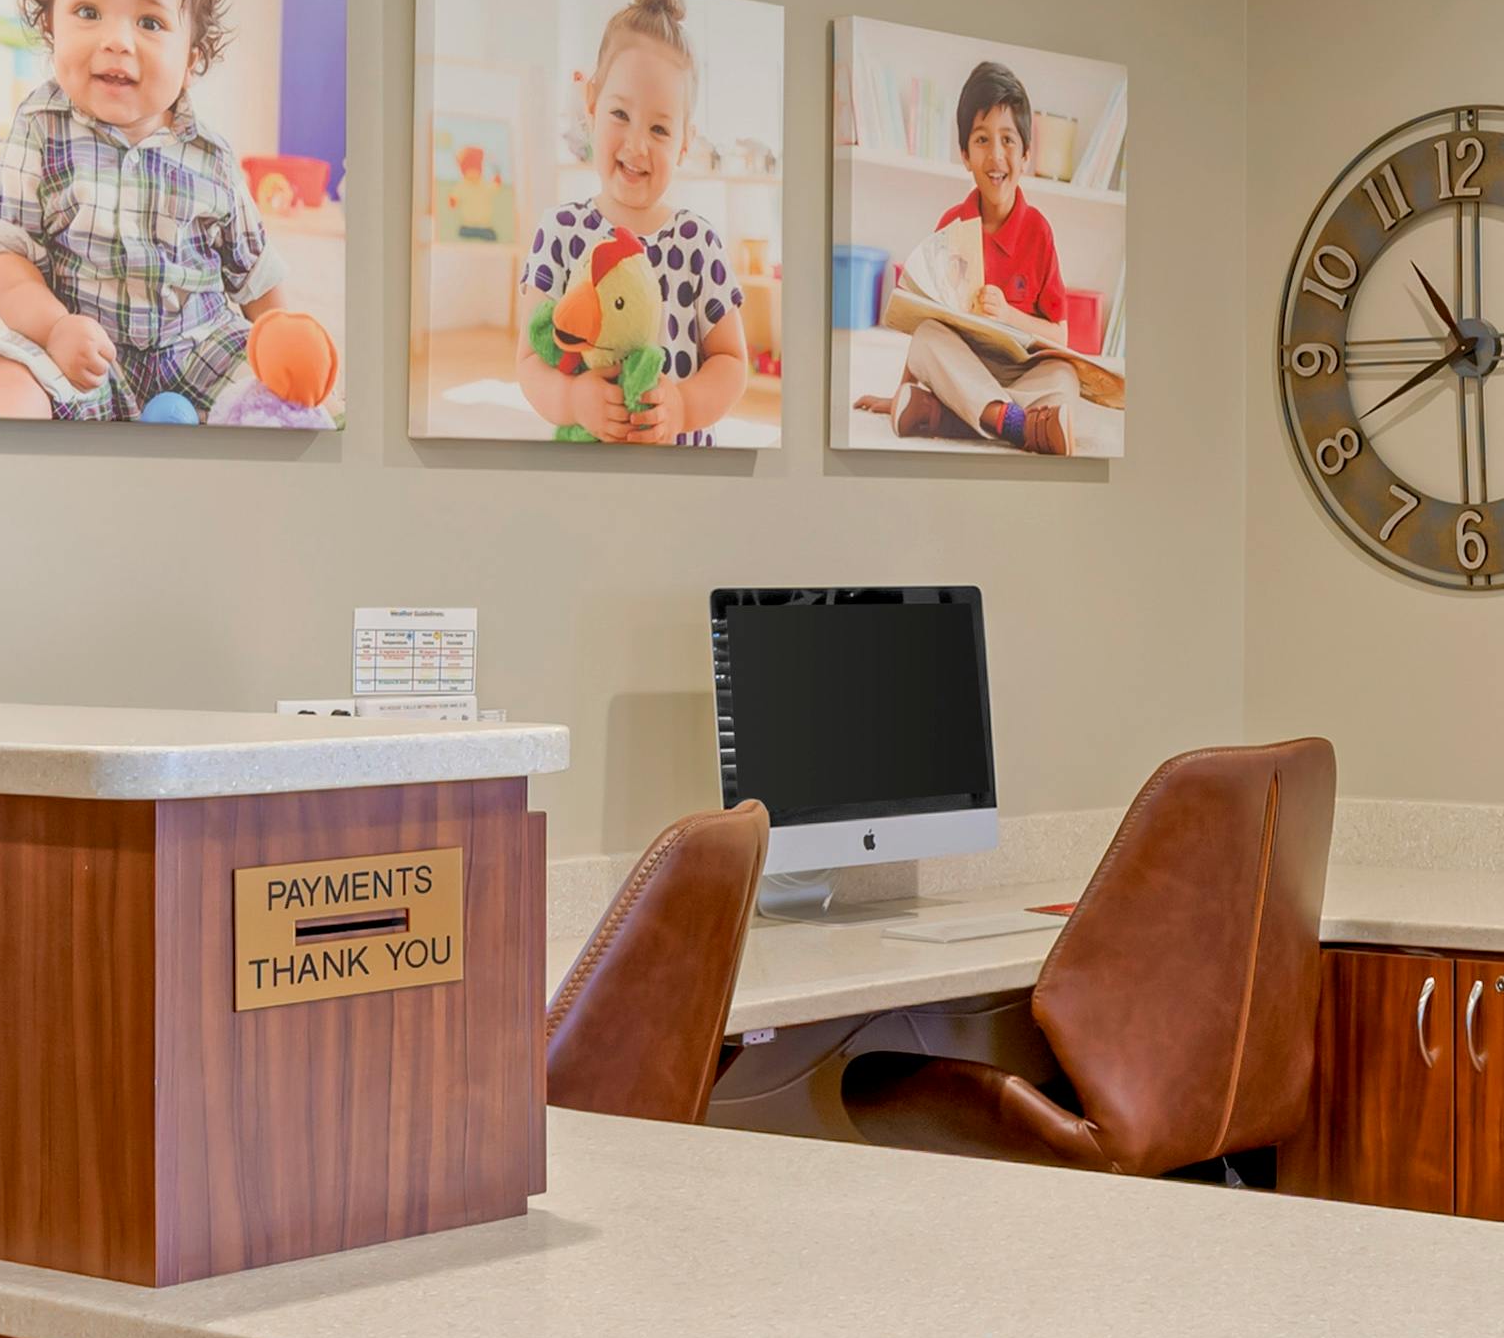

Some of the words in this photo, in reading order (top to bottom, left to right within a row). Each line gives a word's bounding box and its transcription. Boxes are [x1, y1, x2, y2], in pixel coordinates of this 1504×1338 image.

[1433, 136, 1485, 200] 12
[1362, 163, 1412, 233] 11
[1302, 245, 1359, 311] 10
[1290, 342, 1339, 378] 9
[1316, 427, 1361, 477] 8
[1379, 483, 1421, 542] 7
[1455, 510, 1488, 571] 6
[267, 865, 432, 911] PAYMENTS
[248, 945, 369, 989] THANK
[384, 935, 451, 971] YOU
